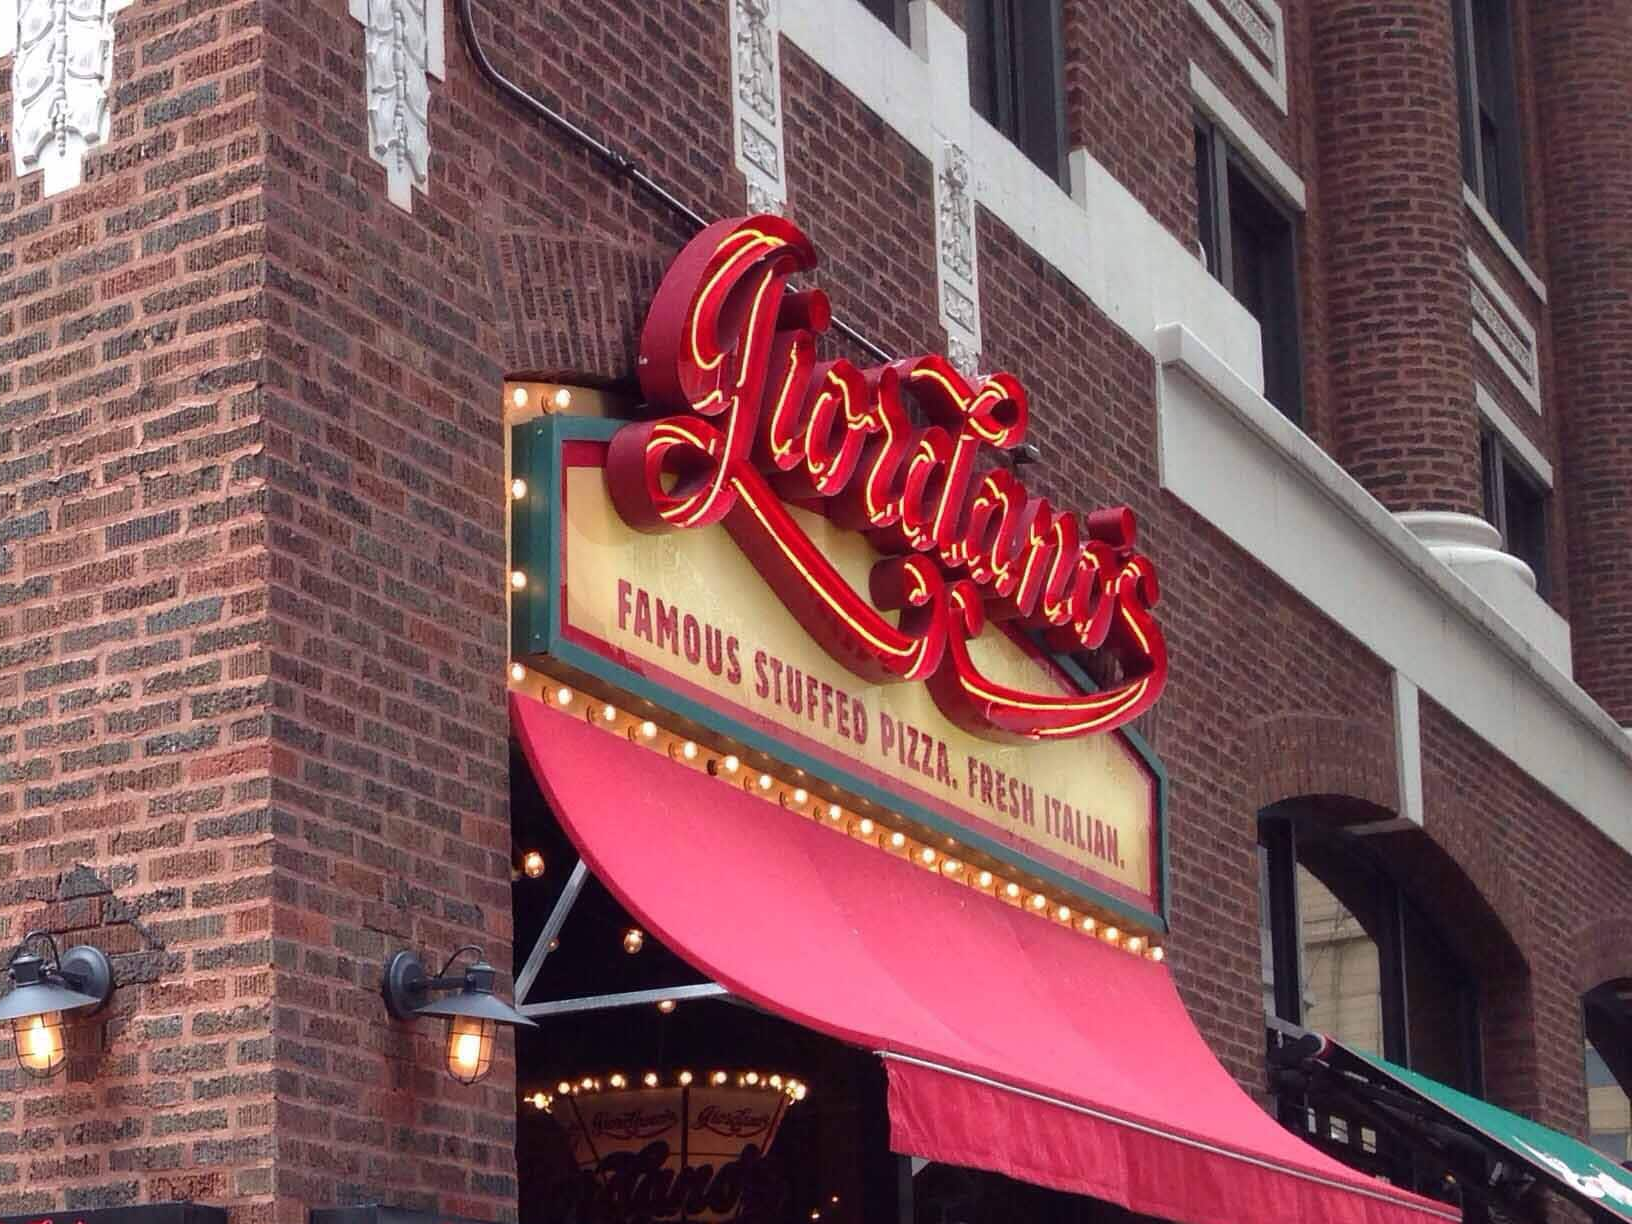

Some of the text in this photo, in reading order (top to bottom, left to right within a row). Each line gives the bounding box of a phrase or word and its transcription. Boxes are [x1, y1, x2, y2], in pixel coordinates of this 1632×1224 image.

[606, 214, 1167, 741] Giordano's
[618, 578, 1125, 870] FAMOUS STUFFED PIZZA. FRESH ITALIAN.
